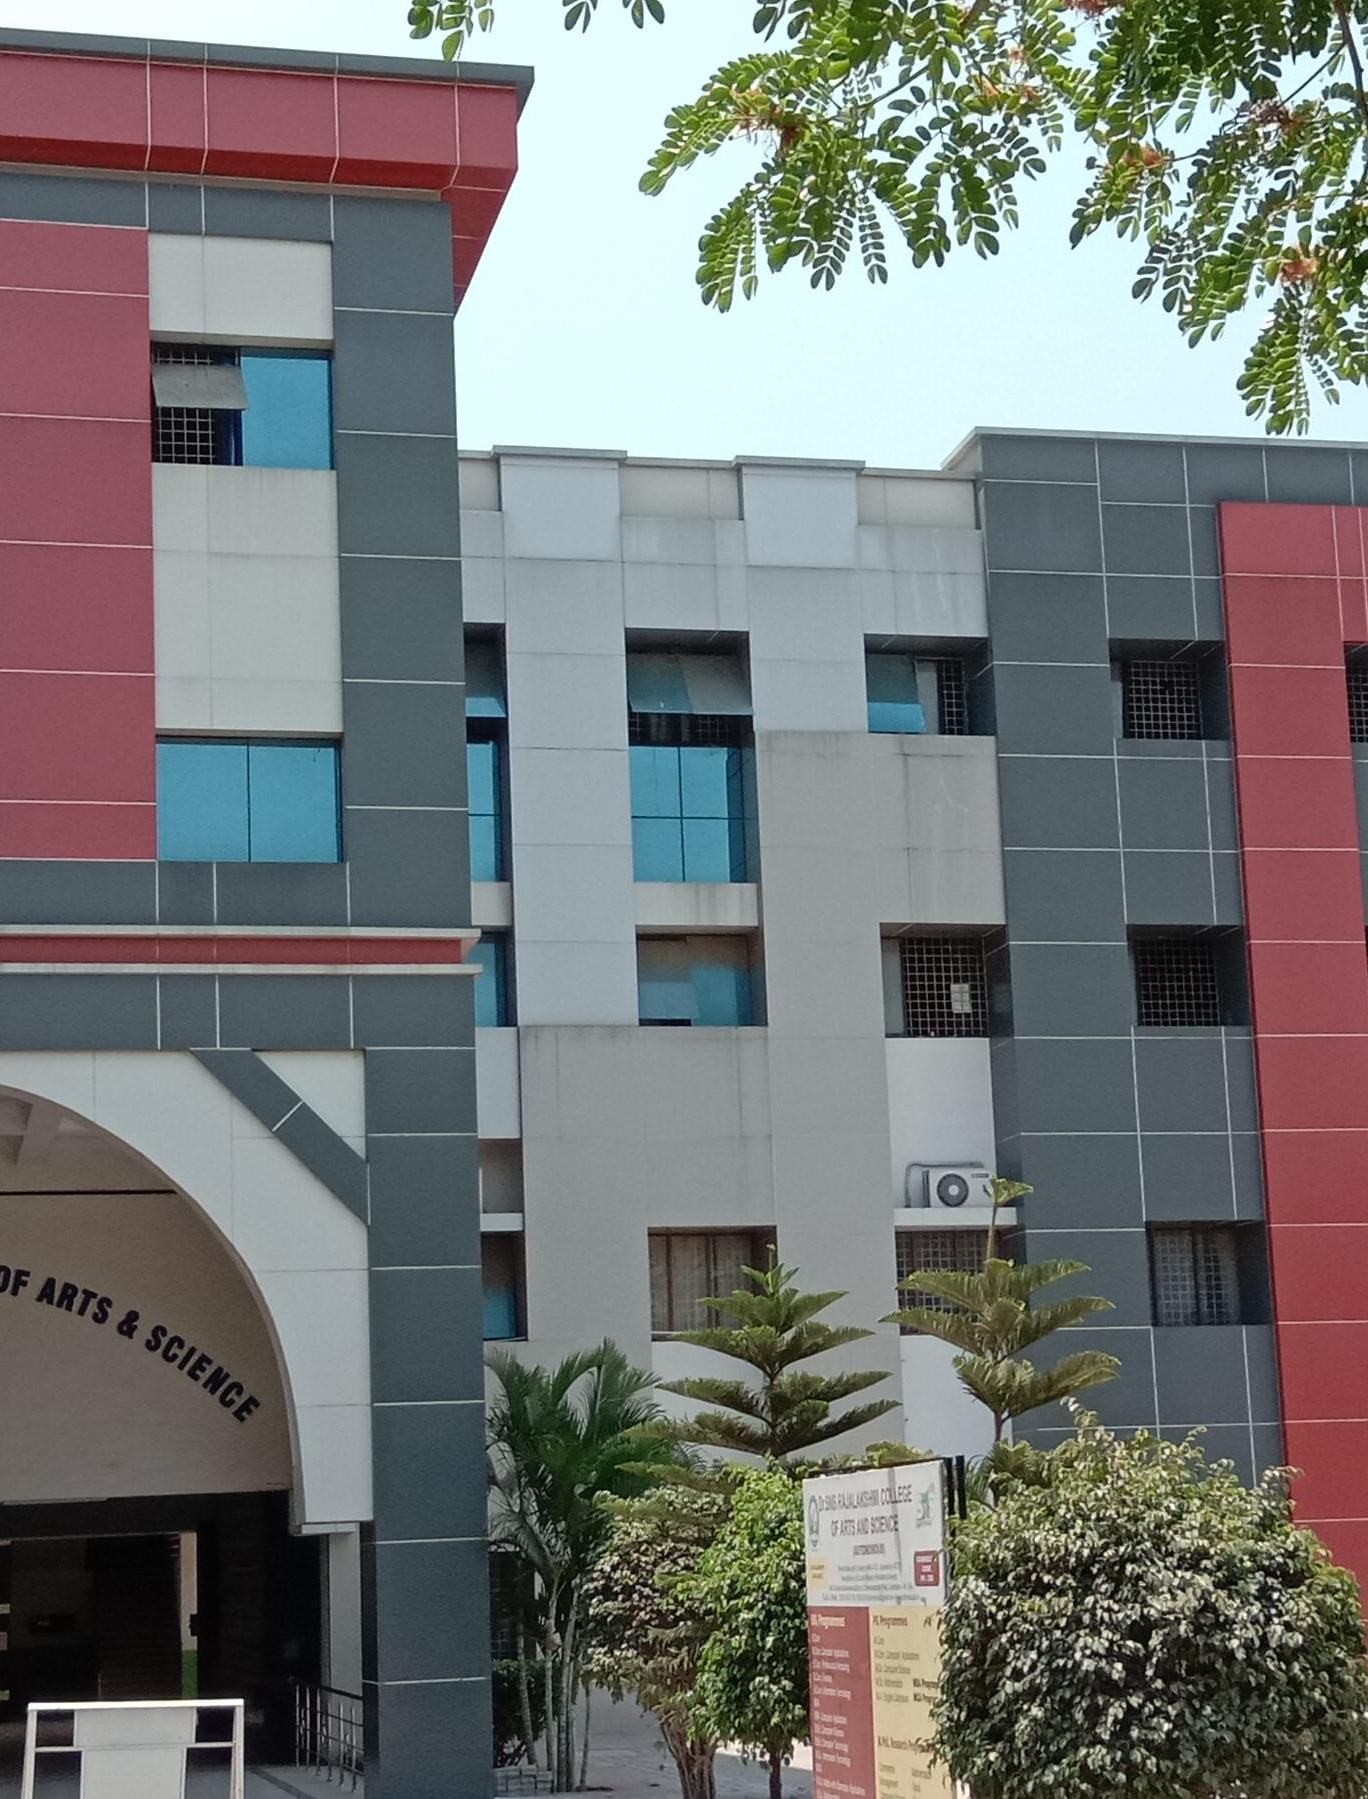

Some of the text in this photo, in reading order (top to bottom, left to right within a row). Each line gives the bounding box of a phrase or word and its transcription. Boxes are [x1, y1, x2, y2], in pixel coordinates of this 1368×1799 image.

[36, 1276, 113, 1325] ARTS
[117, 1309, 140, 1339] &
[144, 1324, 261, 1423] SCIENCE
[880, 1484, 912, 1506] COLLEGE
[831, 1519, 839, 1537] OF
[840, 1518, 855, 1537] ARTS
[856, 1516, 869, 1536] AND
[871, 1514, 899, 1534] SCIENCE
